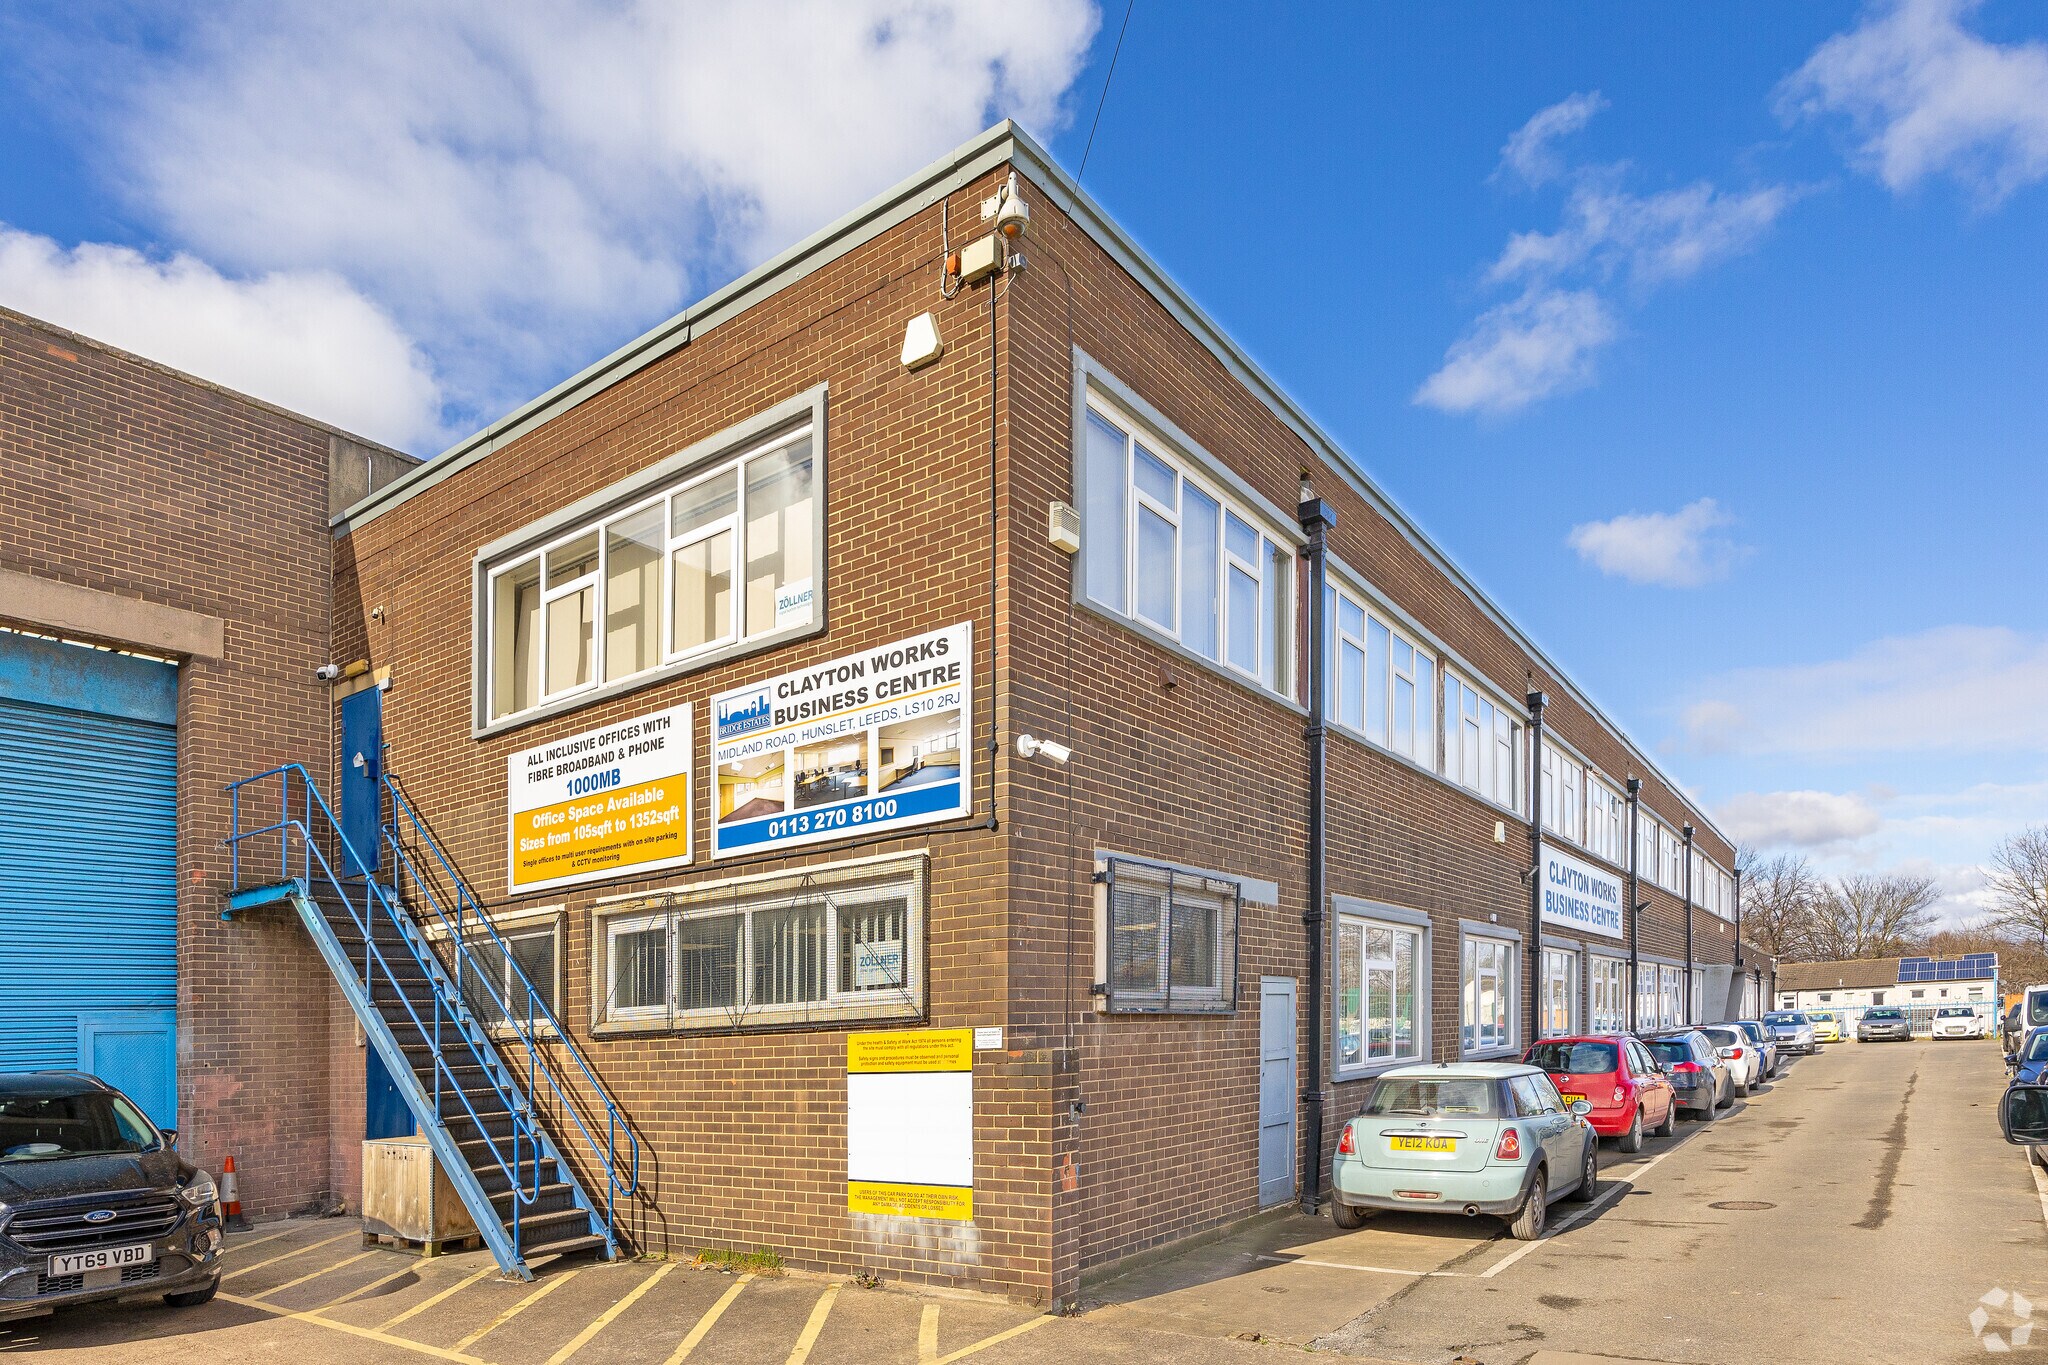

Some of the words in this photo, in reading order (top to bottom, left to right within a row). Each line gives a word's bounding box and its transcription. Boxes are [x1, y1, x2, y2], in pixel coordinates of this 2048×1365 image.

[778, 661, 864, 698] CLAYTON
[871, 638, 949, 673] WORKS
[775, 687, 868, 725] BUSINESS
[876, 662, 960, 698] CENTRE
[527, 754, 544, 767] ALL
[546, 738, 595, 761] INCLUSIVE
[598, 726, 640, 746] OFFICES
[643, 716, 671, 734] WITH
[718, 742, 762, 760] MIDLAND
[765, 734, 798, 750] ROAD,
[802, 719, 856, 741] HUNSLET,
[859, 708, 900, 727] LEEDS,
[904, 698, 934, 716] LS10
[937, 692, 961, 708] 2RJ
[720, 723, 742, 734] BRIDGE
[744, 715, 770, 728] ESTATES
[528, 768, 553, 783] FIBRE
[556, 751, 614, 776] BROADBAND
[618, 748, 625, 759] &
[628, 737, 664, 757] PHONE
[566, 768, 621, 796] 1000MB
[532, 812, 565, 828] Office
[568, 802, 604, 823] Space
[607, 787, 664, 811] Available
[768, 816, 809, 838] 0113
[814, 808, 846, 830] 270
[852, 799, 897, 822] 8100
[520, 838, 545, 851] Sizes
[548, 832, 570, 846] from
[573, 822, 612, 840] 105sqft
[615, 819, 626, 832] to
[629, 805, 679, 828] 1352sqft
[523, 859, 537, 868] Single
[538, 856, 554, 865] offices
[562, 852, 574, 860] multi
[587, 843, 622, 855] requirements
[623, 839, 635, 848] with
[644, 835, 655, 844] site
[656, 831, 678, 843] parking
[576, 858, 591, 867] CCTV
[592, 854, 620, 864] monitoring
[1549, 860, 1589, 894] CLAYTON
[1591, 878, 1616, 904] WORKS
[1546, 890, 1589, 922] BUSINESS
[1592, 905, 1619, 929] CENTRE
[1399, 1137, 1422, 1148] YE12
[61, 1253, 107, 1271] YT69
[113, 1247, 144, 1263] VBD
